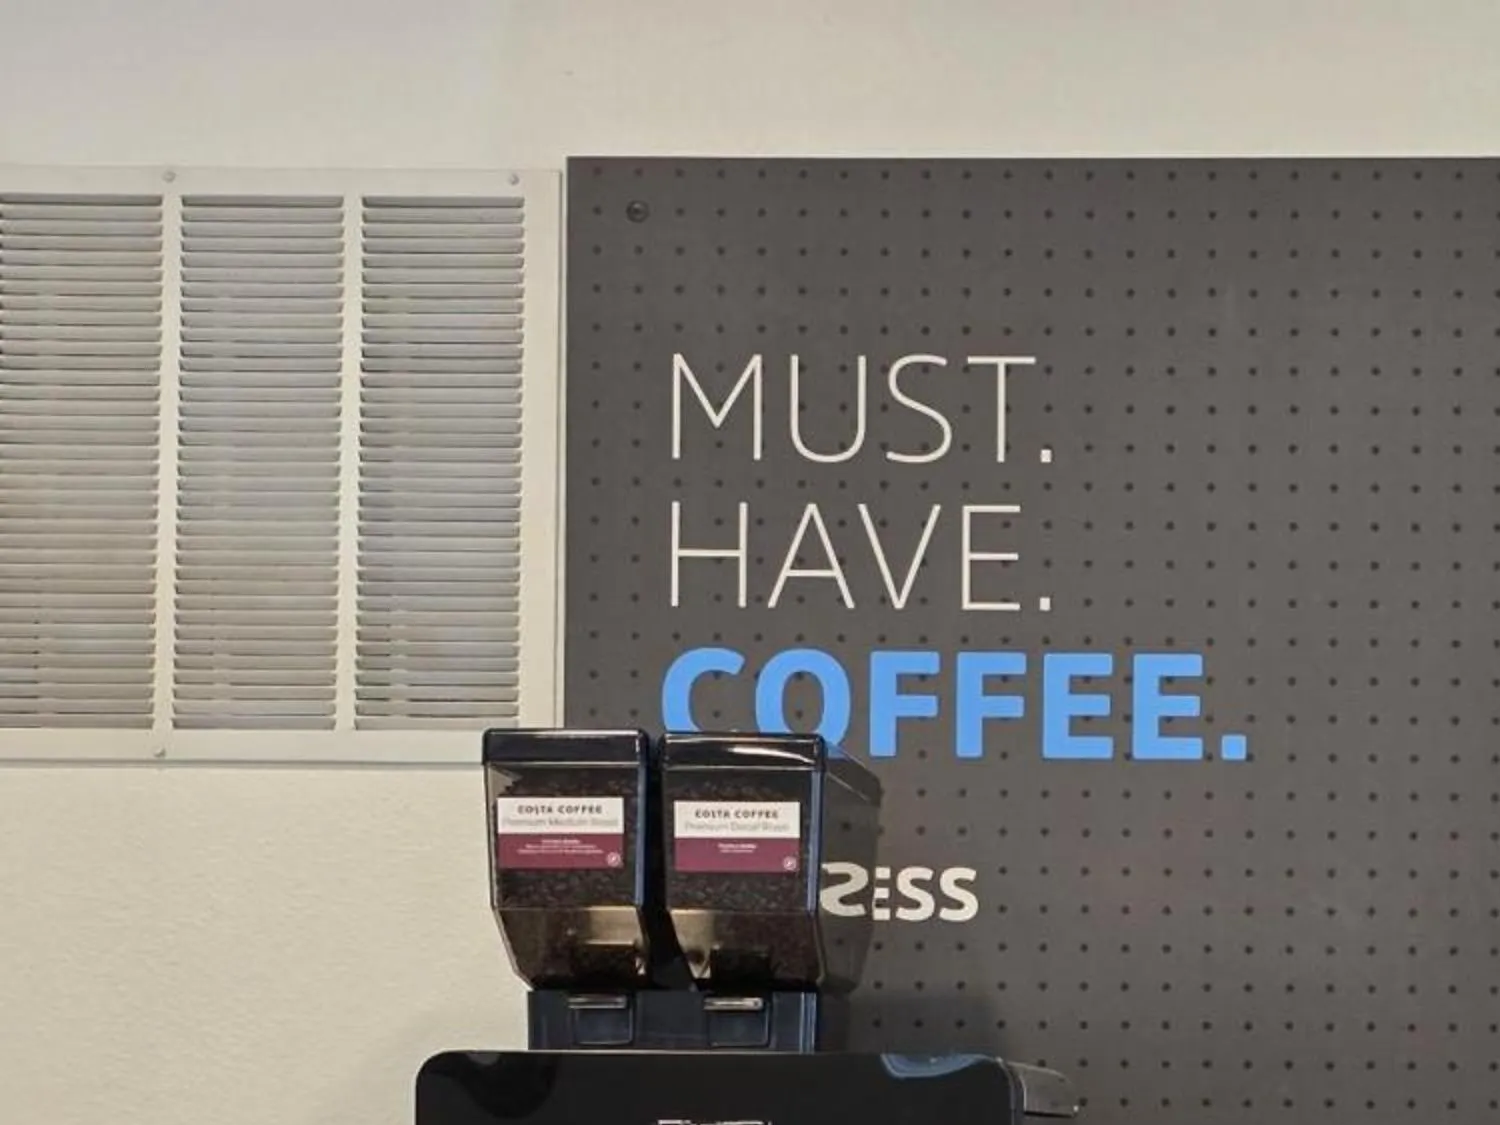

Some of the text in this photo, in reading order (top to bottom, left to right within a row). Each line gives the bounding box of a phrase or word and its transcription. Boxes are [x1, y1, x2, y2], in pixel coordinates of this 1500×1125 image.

[672, 353, 1052, 463] MUST.
[671, 501, 1051, 611] HAVE.
[661, 647, 1247, 760] COFFEE.
